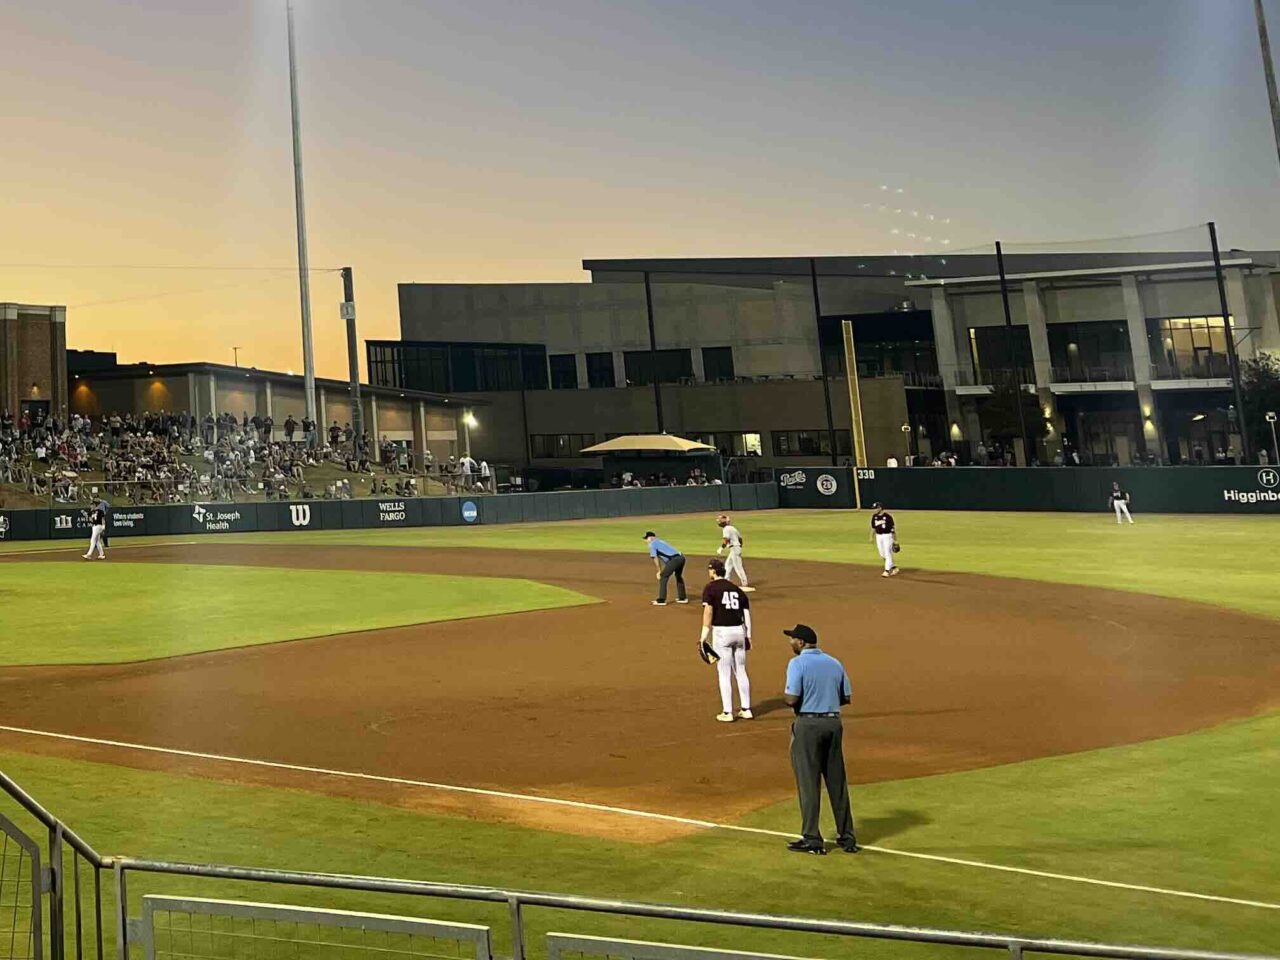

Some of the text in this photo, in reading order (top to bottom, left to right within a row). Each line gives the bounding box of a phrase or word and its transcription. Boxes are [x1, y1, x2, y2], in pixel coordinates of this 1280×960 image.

[858, 469, 875, 479] 330
[1262, 472, 1274, 484] H
[1223, 489, 1280, 503] Higginb
[379, 502, 405, 511] WELLS
[205, 510, 240, 520] St. Joseph
[380, 512, 406, 521] FARGO
[206, 521, 230, 530] Health
[721, 591, 740, 610] 46
